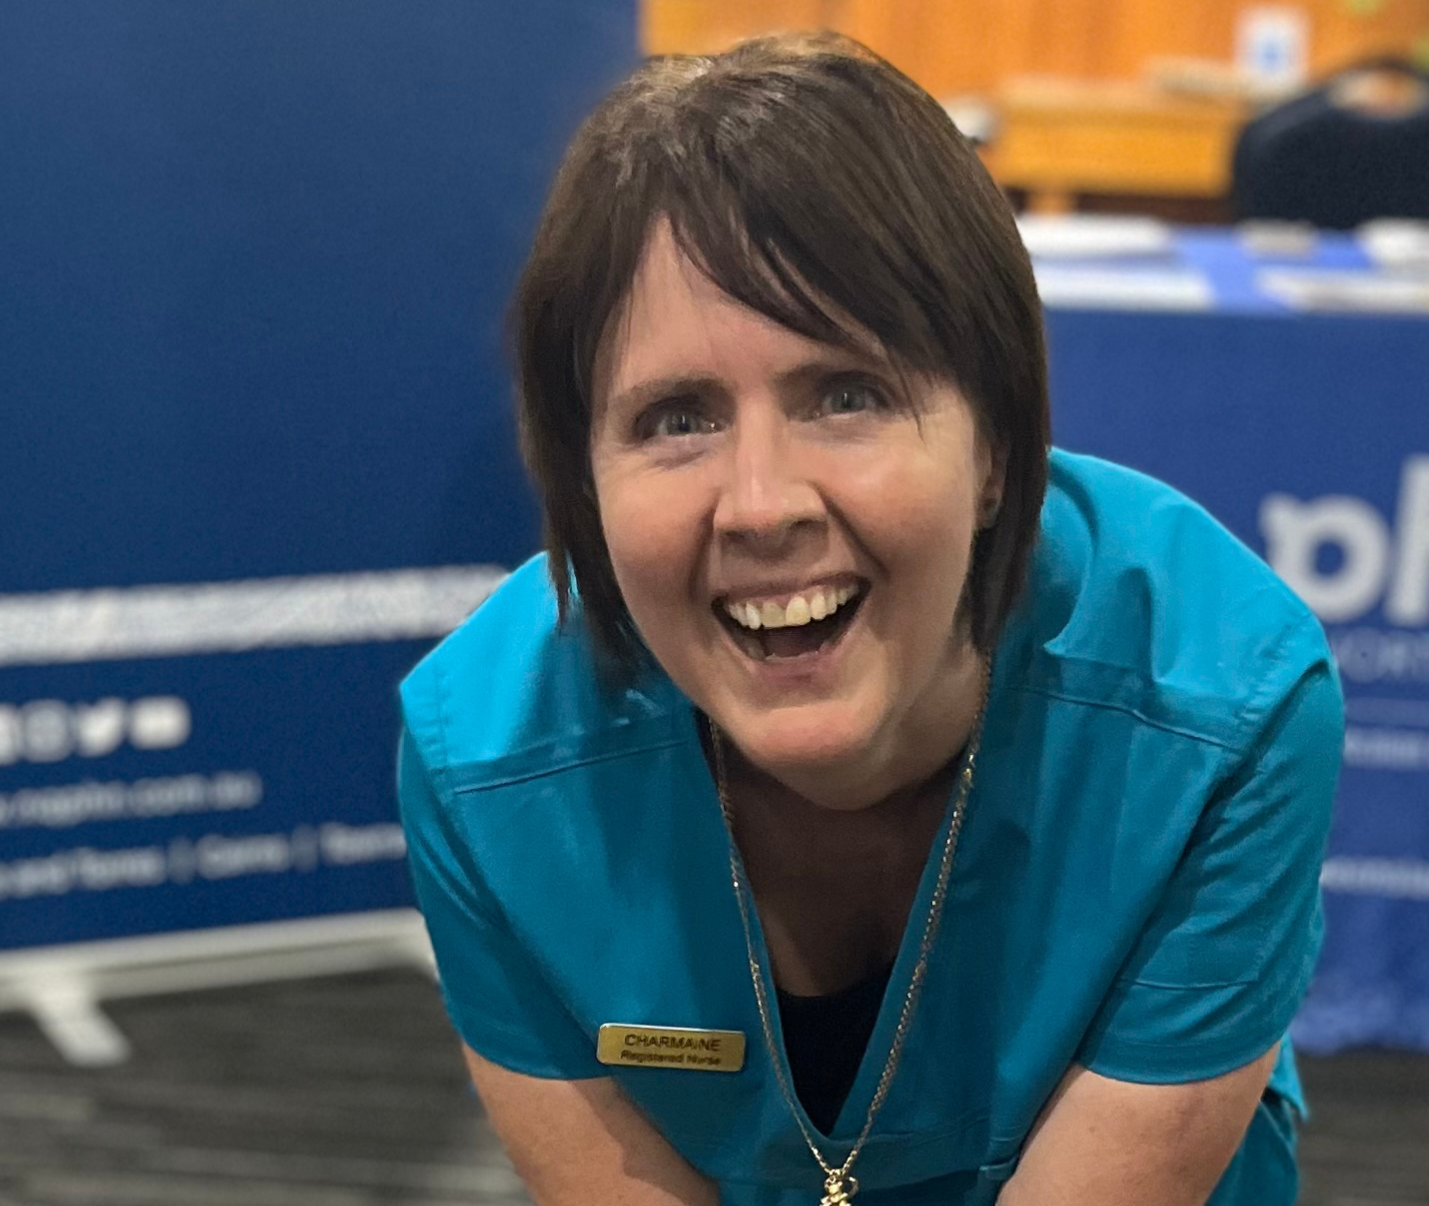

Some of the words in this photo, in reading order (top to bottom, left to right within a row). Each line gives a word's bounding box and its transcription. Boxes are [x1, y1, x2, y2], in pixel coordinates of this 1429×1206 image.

[624, 1033, 722, 1052] CHARMAINE
[620, 1050, 684, 1063] Registered
[686, 1055, 722, 1066] Nurse
